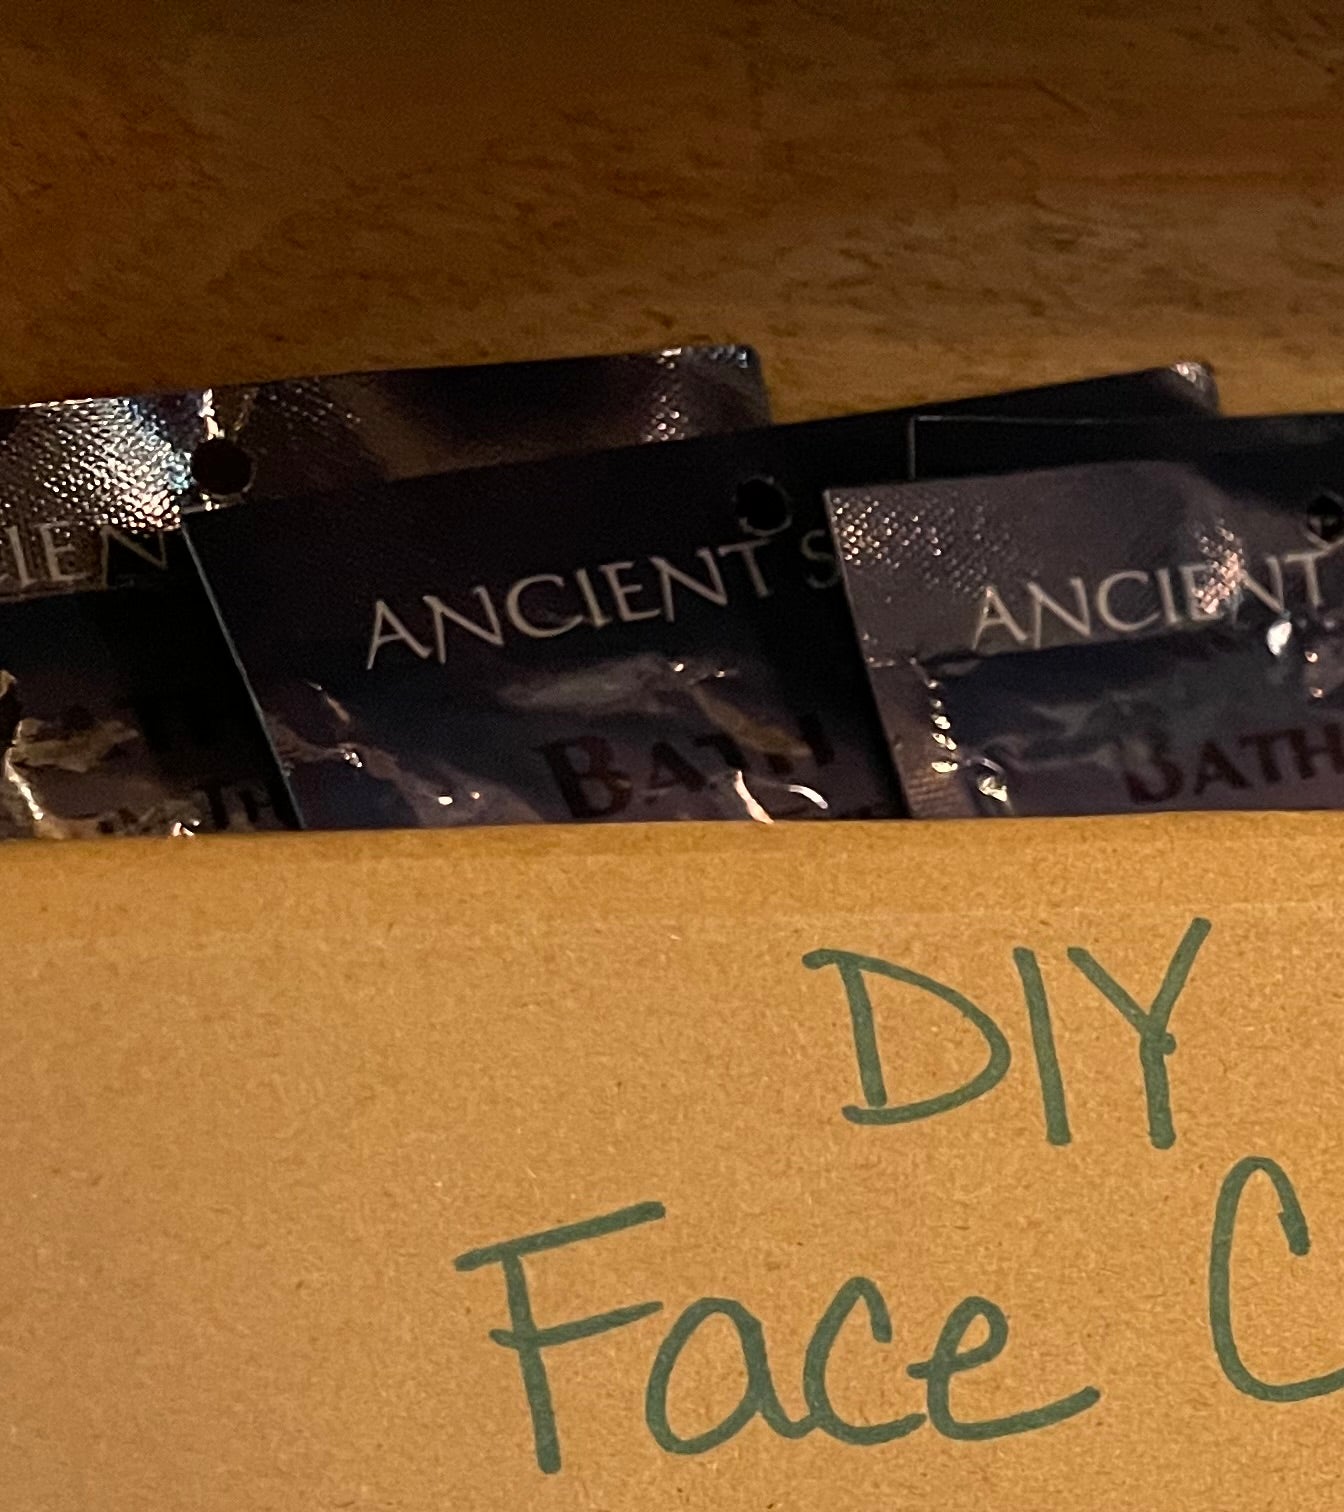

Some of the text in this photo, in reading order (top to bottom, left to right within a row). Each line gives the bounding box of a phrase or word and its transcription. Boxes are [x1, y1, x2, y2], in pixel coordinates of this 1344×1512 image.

[366, 537, 775, 669] ANCIENT
[970, 548, 1327, 650] ANCIENT
[803, 917, 1212, 1150] DIY
[455, 1200, 1101, 1475] Face
